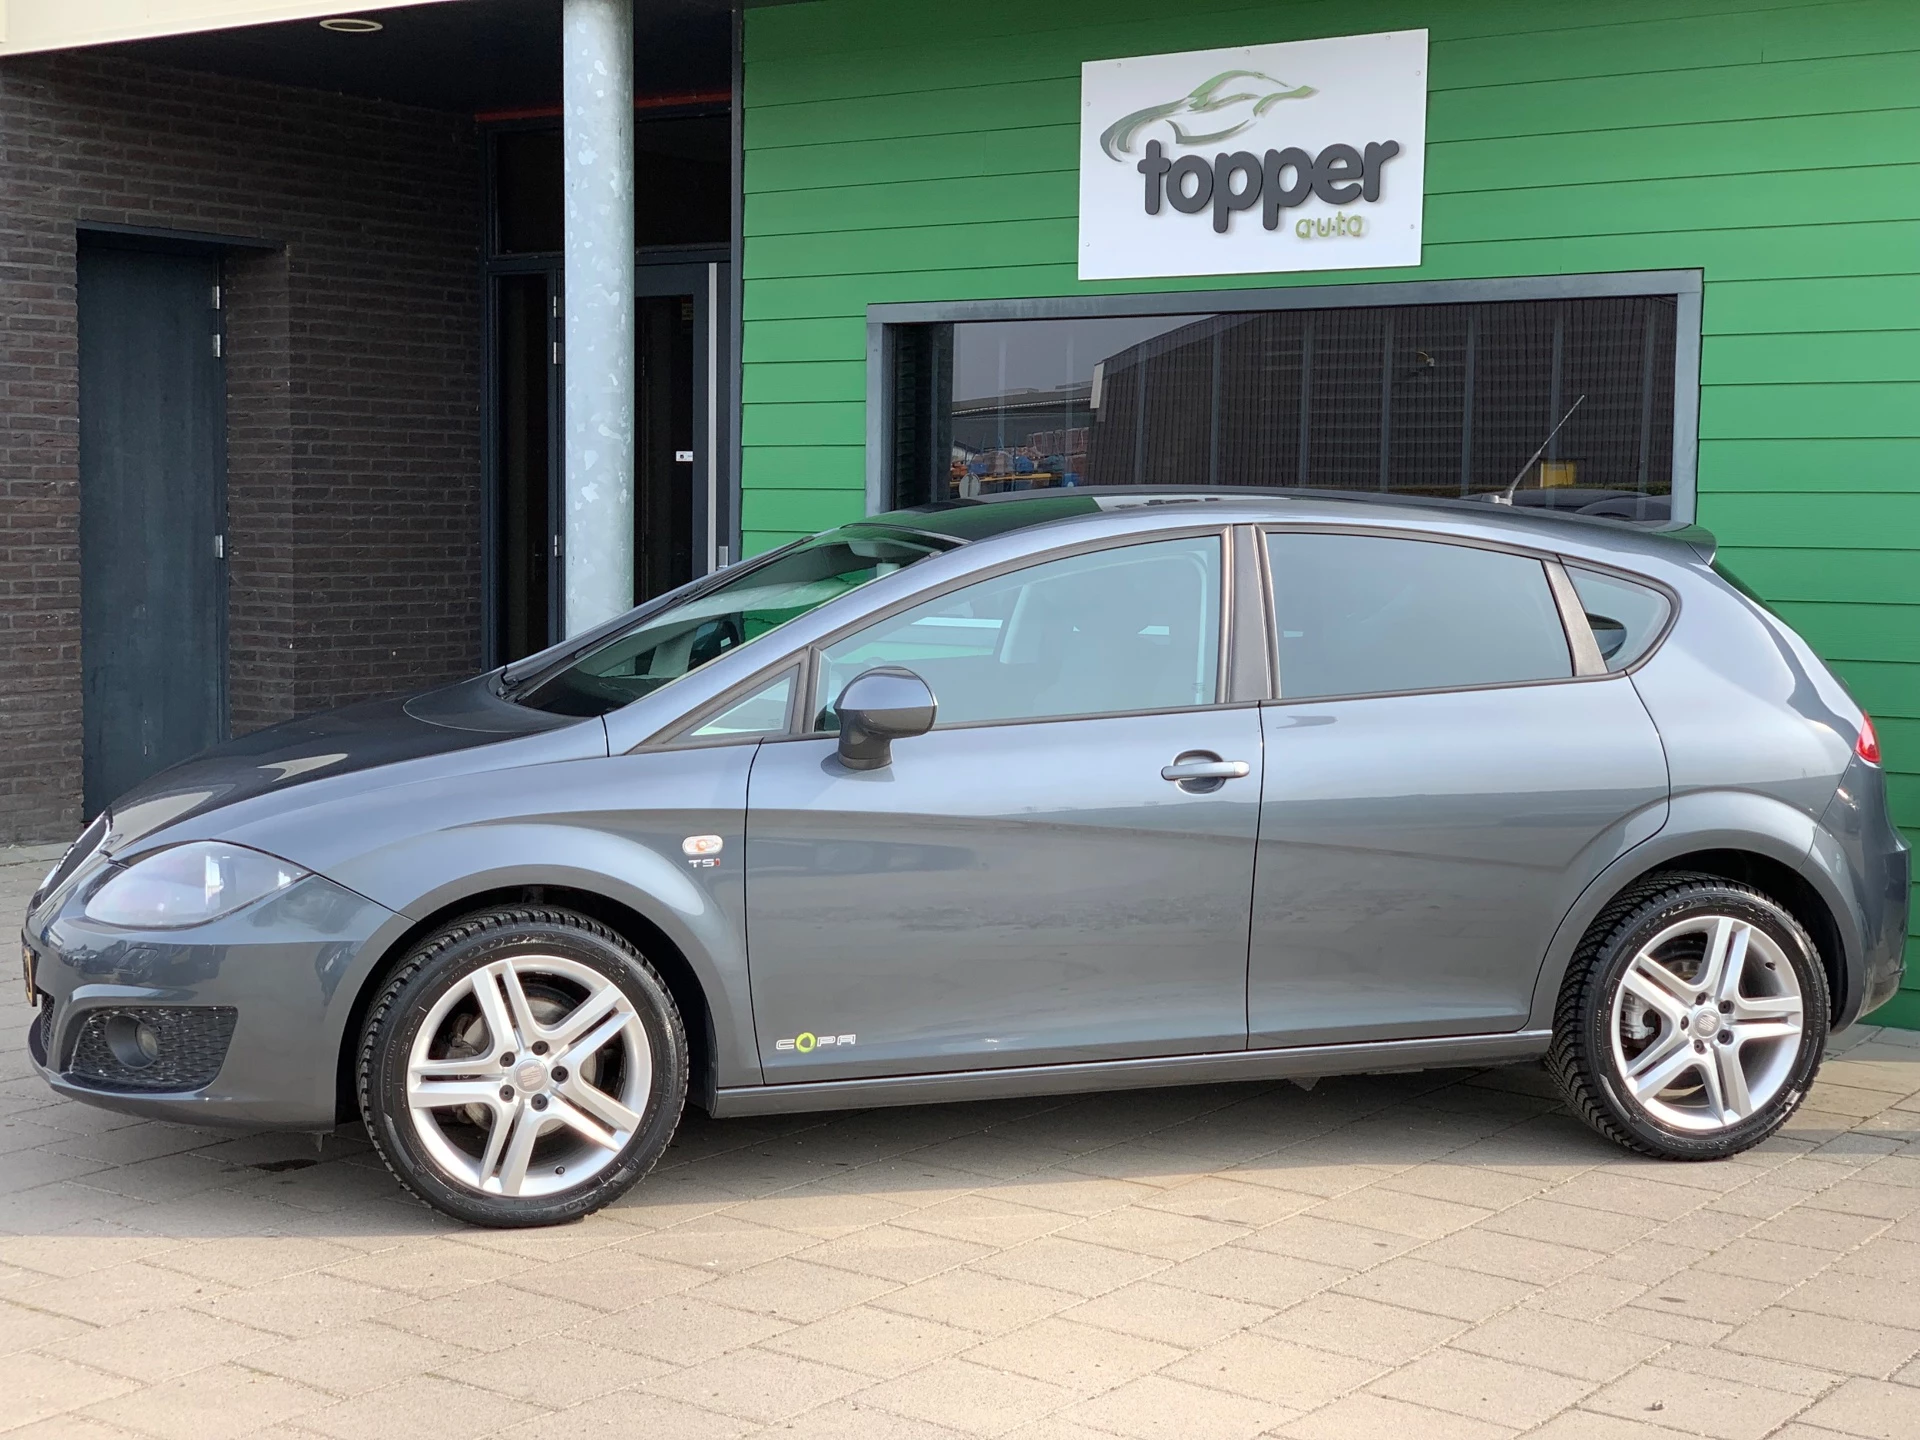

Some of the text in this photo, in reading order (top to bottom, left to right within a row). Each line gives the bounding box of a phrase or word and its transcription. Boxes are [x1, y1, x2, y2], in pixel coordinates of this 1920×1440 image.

[1137, 139, 1400, 233] topper
[1296, 211, 1362, 239] auto
[776, 1032, 856, 1053] COPA
